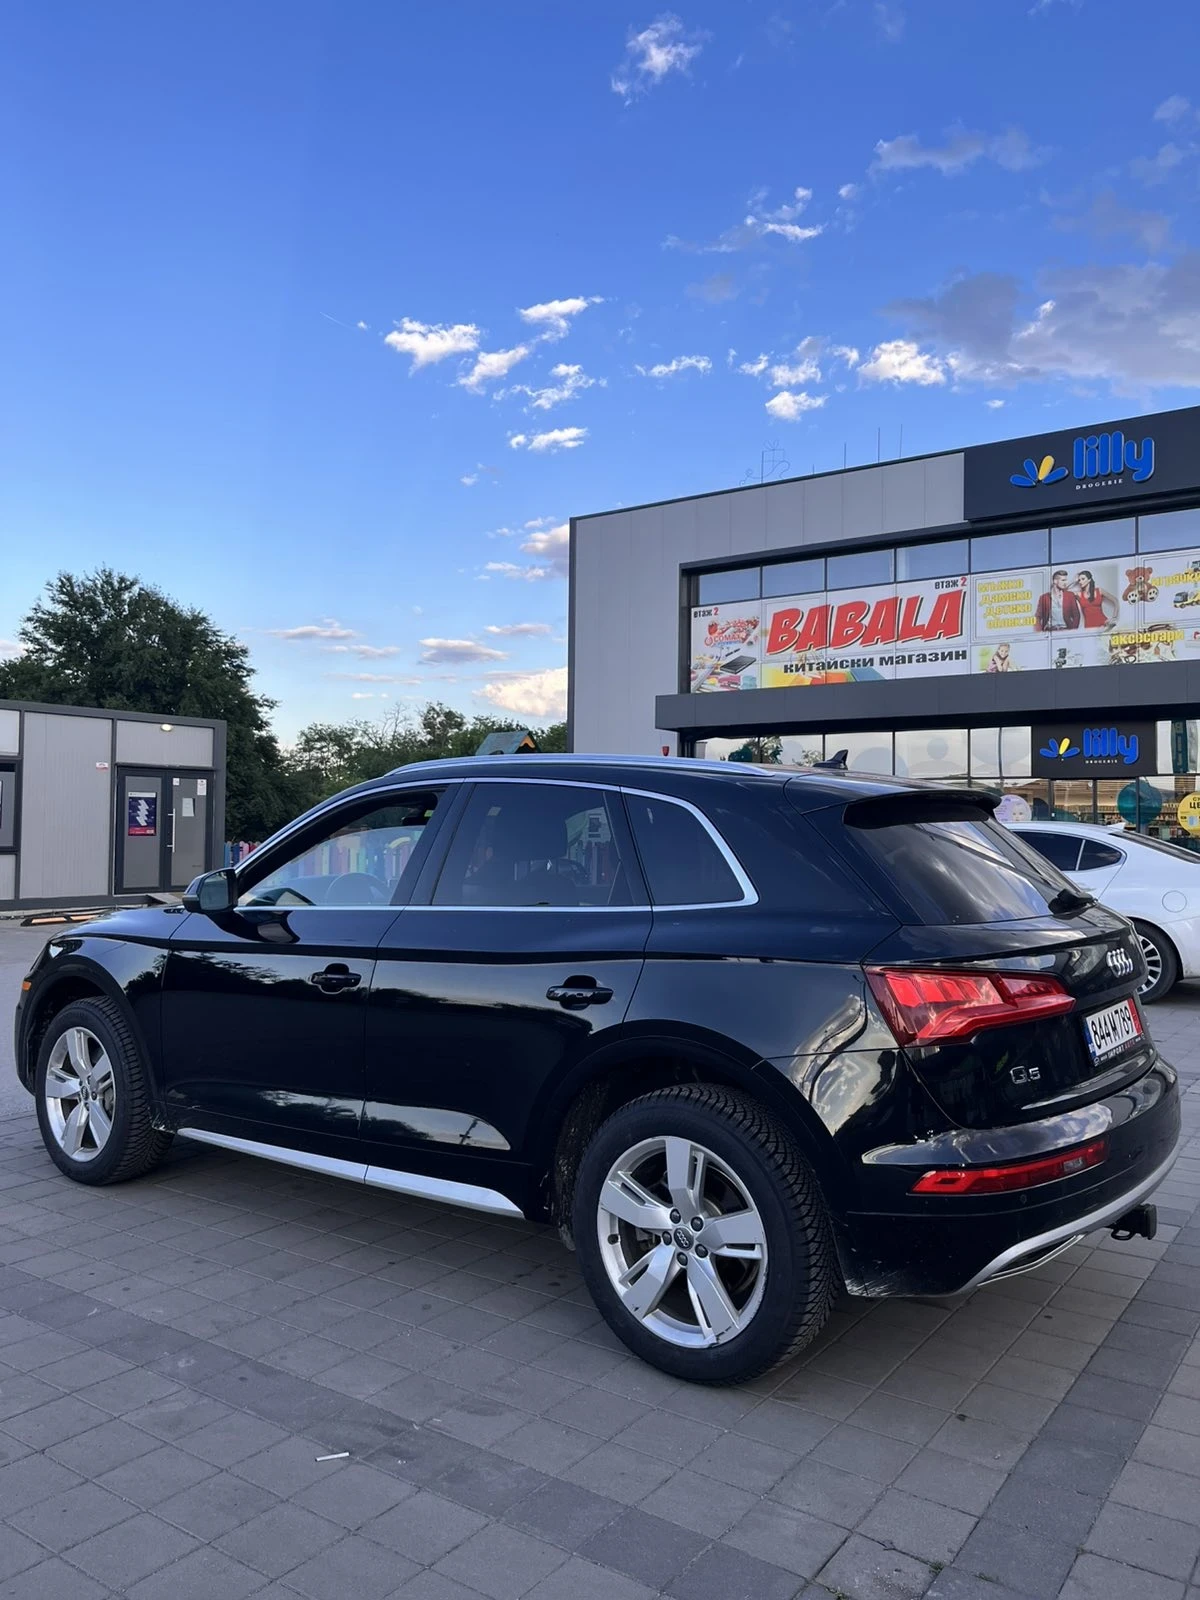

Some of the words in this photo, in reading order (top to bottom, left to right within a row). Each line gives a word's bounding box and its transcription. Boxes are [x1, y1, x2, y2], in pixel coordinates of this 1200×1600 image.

[1073, 431, 1155, 482] lilly
[1075, 478, 1124, 490] DROGERIE
[960, 576, 967, 588] 2
[979, 591, 1032, 606] дамско
[713, 607, 719, 616] 2
[984, 603, 1032, 618] детско
[766, 589, 966, 656] BABALA
[1110, 630, 1184, 646] аксесоари
[783, 654, 875, 674] китайски
[879, 650, 967, 667] магазин
[1083, 728, 1139, 765] lilly
[1009, 1065, 1041, 1084] Q5
